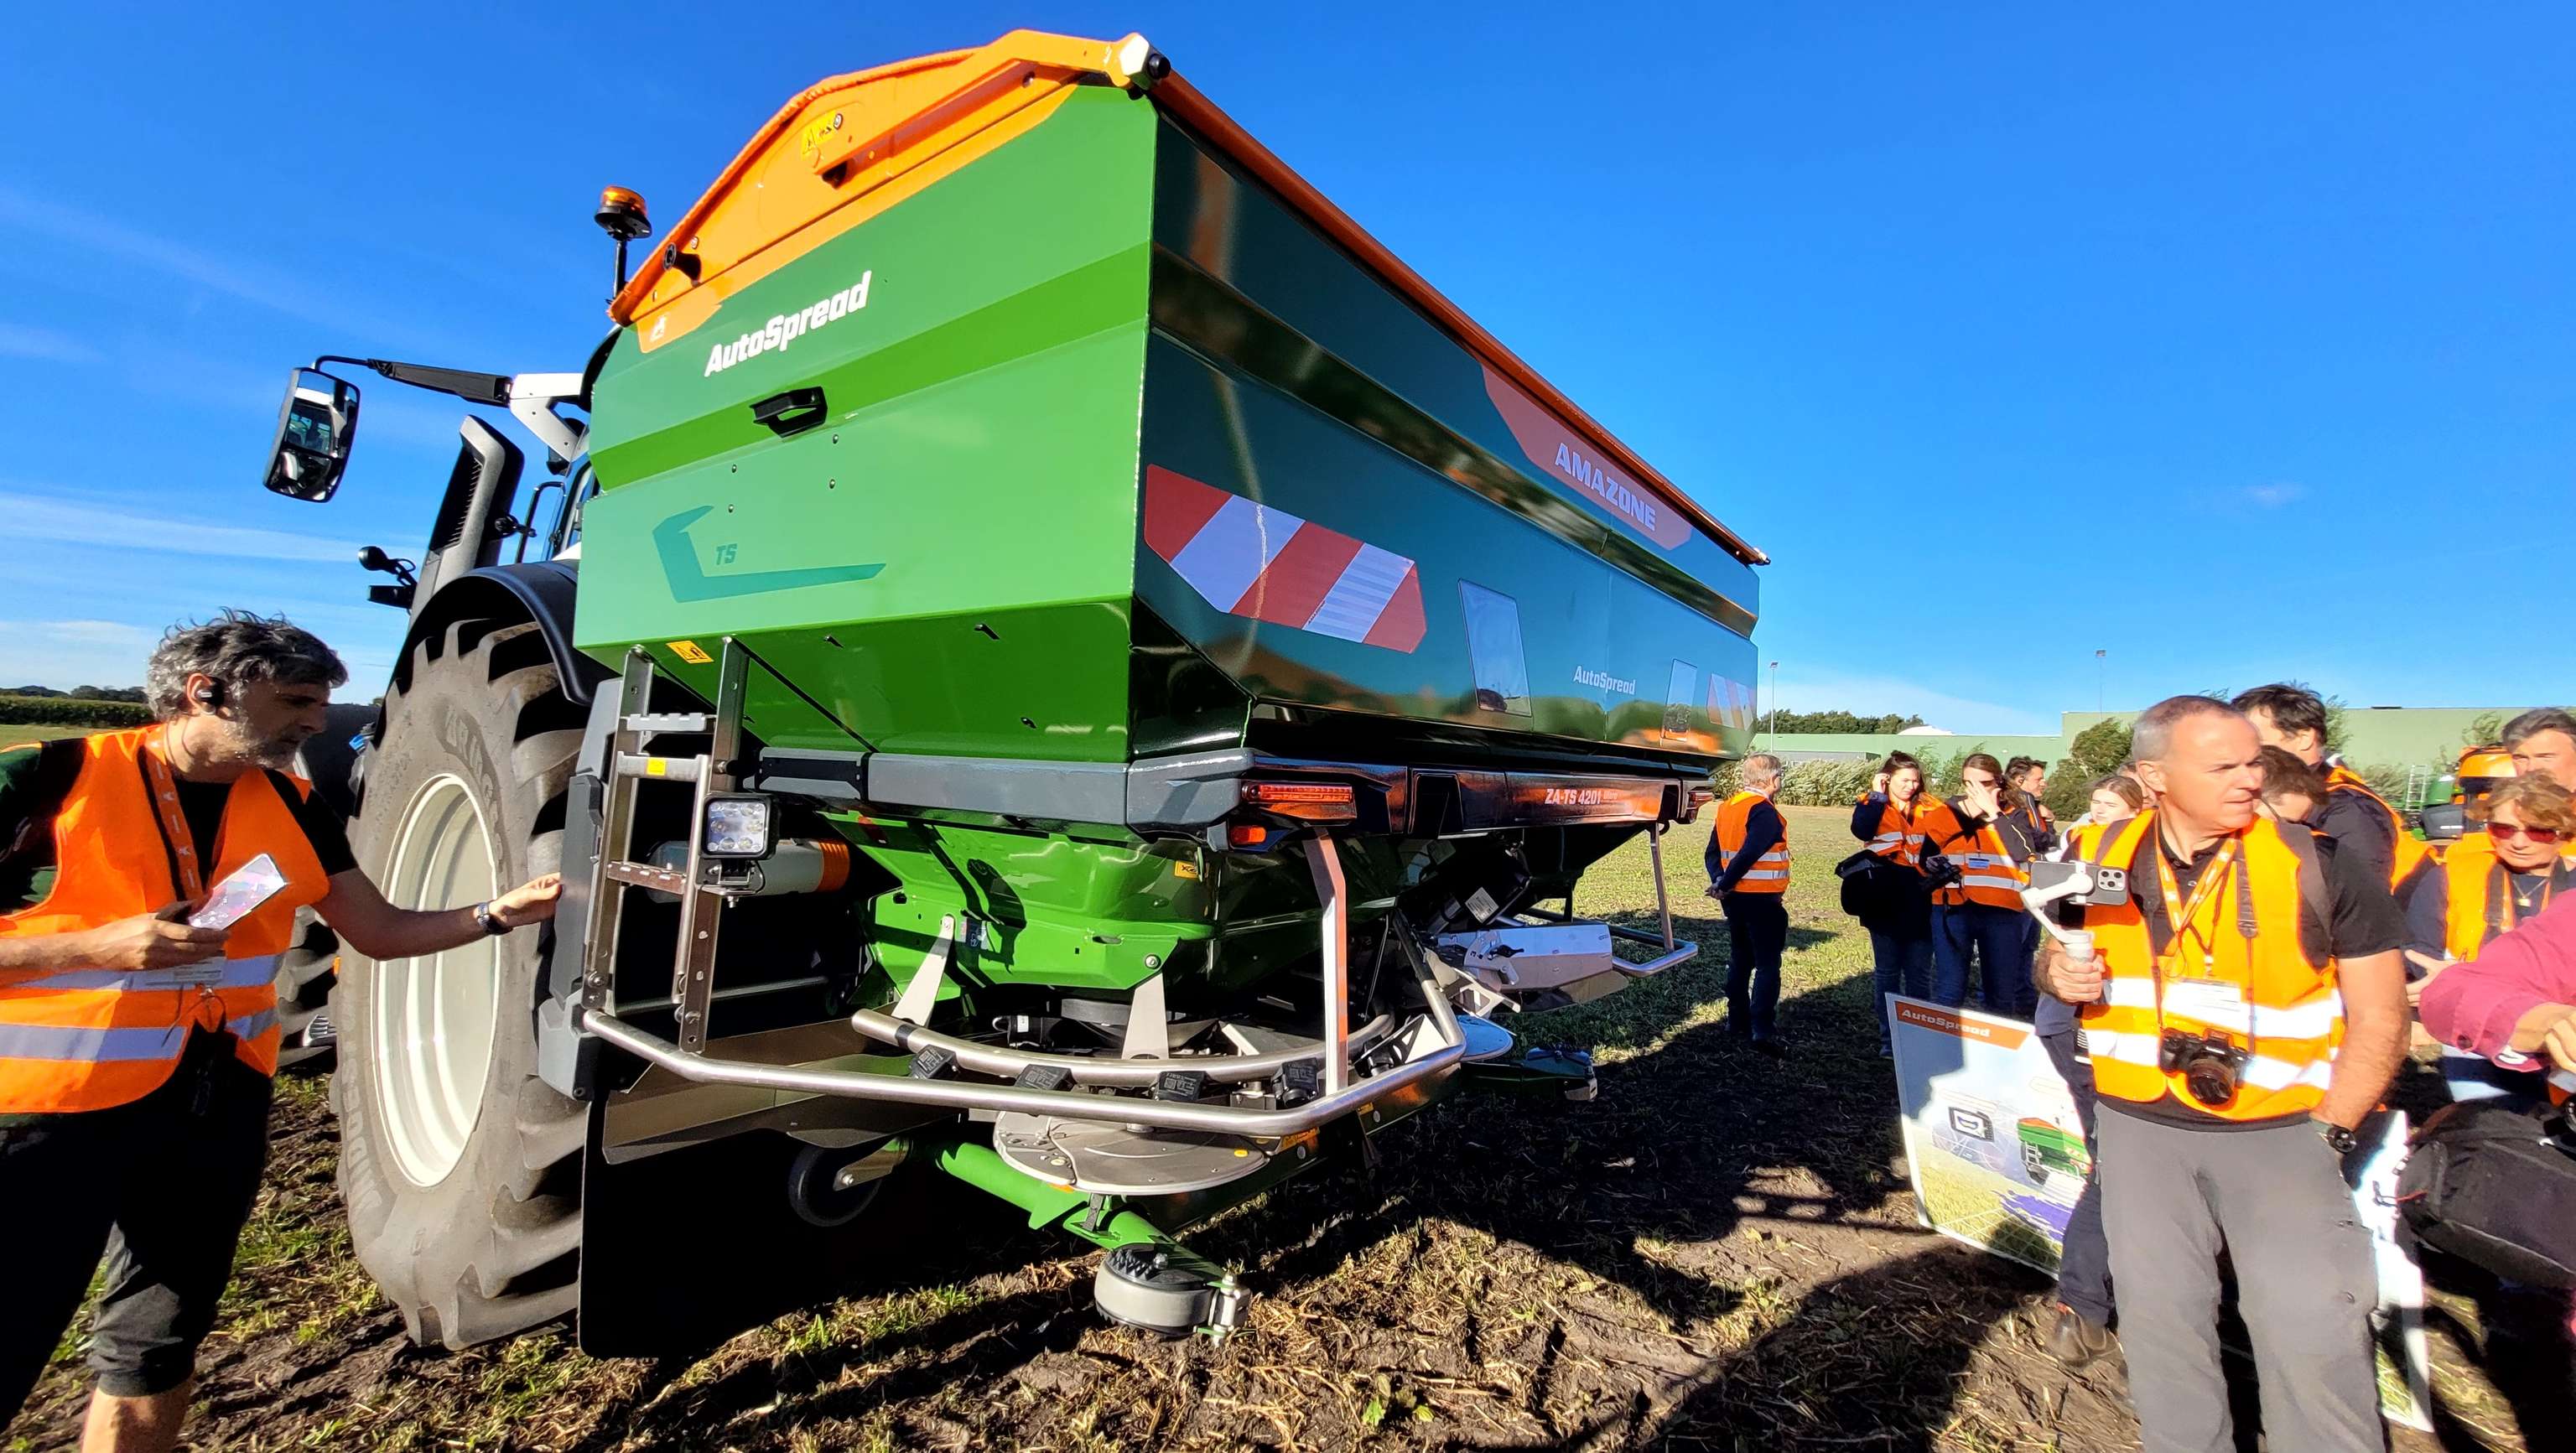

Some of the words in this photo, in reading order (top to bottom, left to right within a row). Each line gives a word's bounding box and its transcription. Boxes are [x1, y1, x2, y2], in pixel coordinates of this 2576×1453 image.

[704, 270, 872, 377] AutoSpread
[1555, 442, 1656, 532] AMAZONE
[716, 543, 737, 565] TS
[1573, 665, 1636, 695] AutoSpread
[1545, 788, 1577, 805] ZA-TS
[1578, 789, 1601, 805] 4201
[1902, 1009, 1991, 1037] AutoSpread
